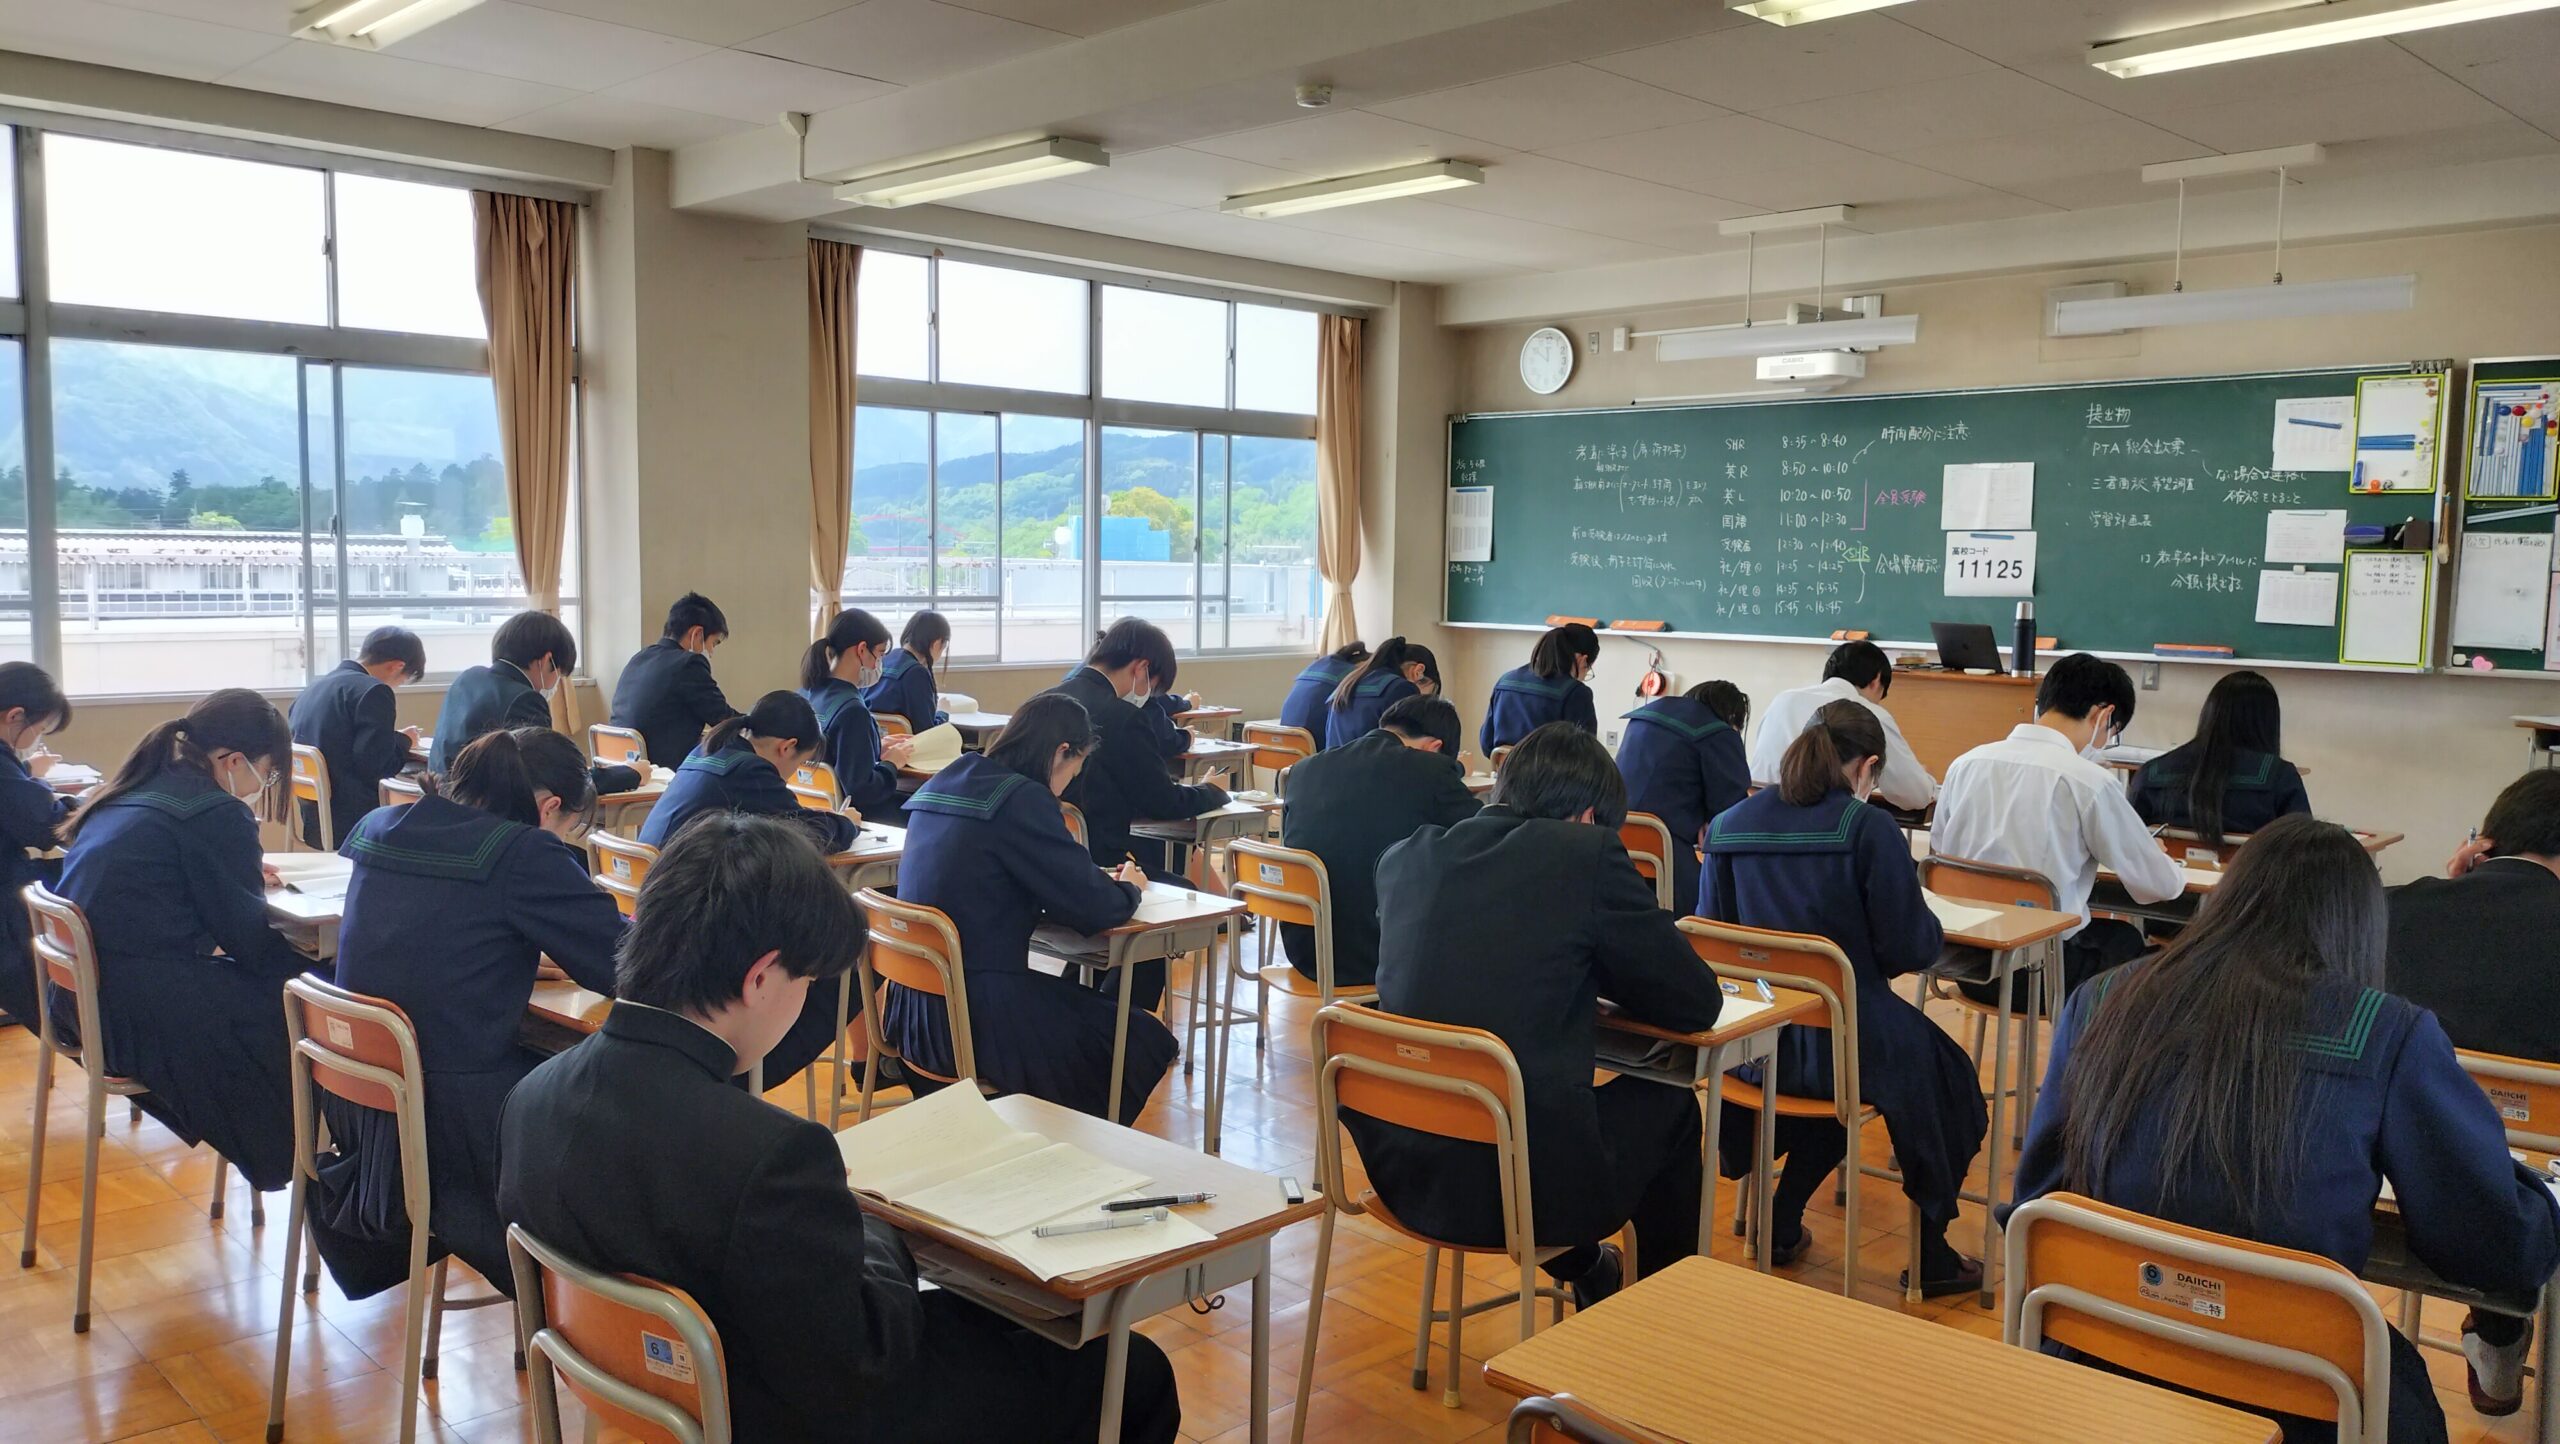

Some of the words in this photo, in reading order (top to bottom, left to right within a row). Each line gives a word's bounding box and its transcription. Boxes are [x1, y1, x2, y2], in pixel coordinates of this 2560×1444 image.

[2086, 402, 2131, 424] 提出物
[1725, 438, 1745, 451] SHR
[2092, 441, 2120, 456] PTA
[1722, 513, 1747, 529] 国語
[1952, 547, 1989, 555] 高校コード
[1958, 560, 2023, 578] 11125
[2490, 1088, 2526, 1101] DAIICHI
[2177, 1273, 2221, 1291] DAIICHI
[2209, 1304, 2221, 1317] 特
[651, 1342, 660, 1355] 6
